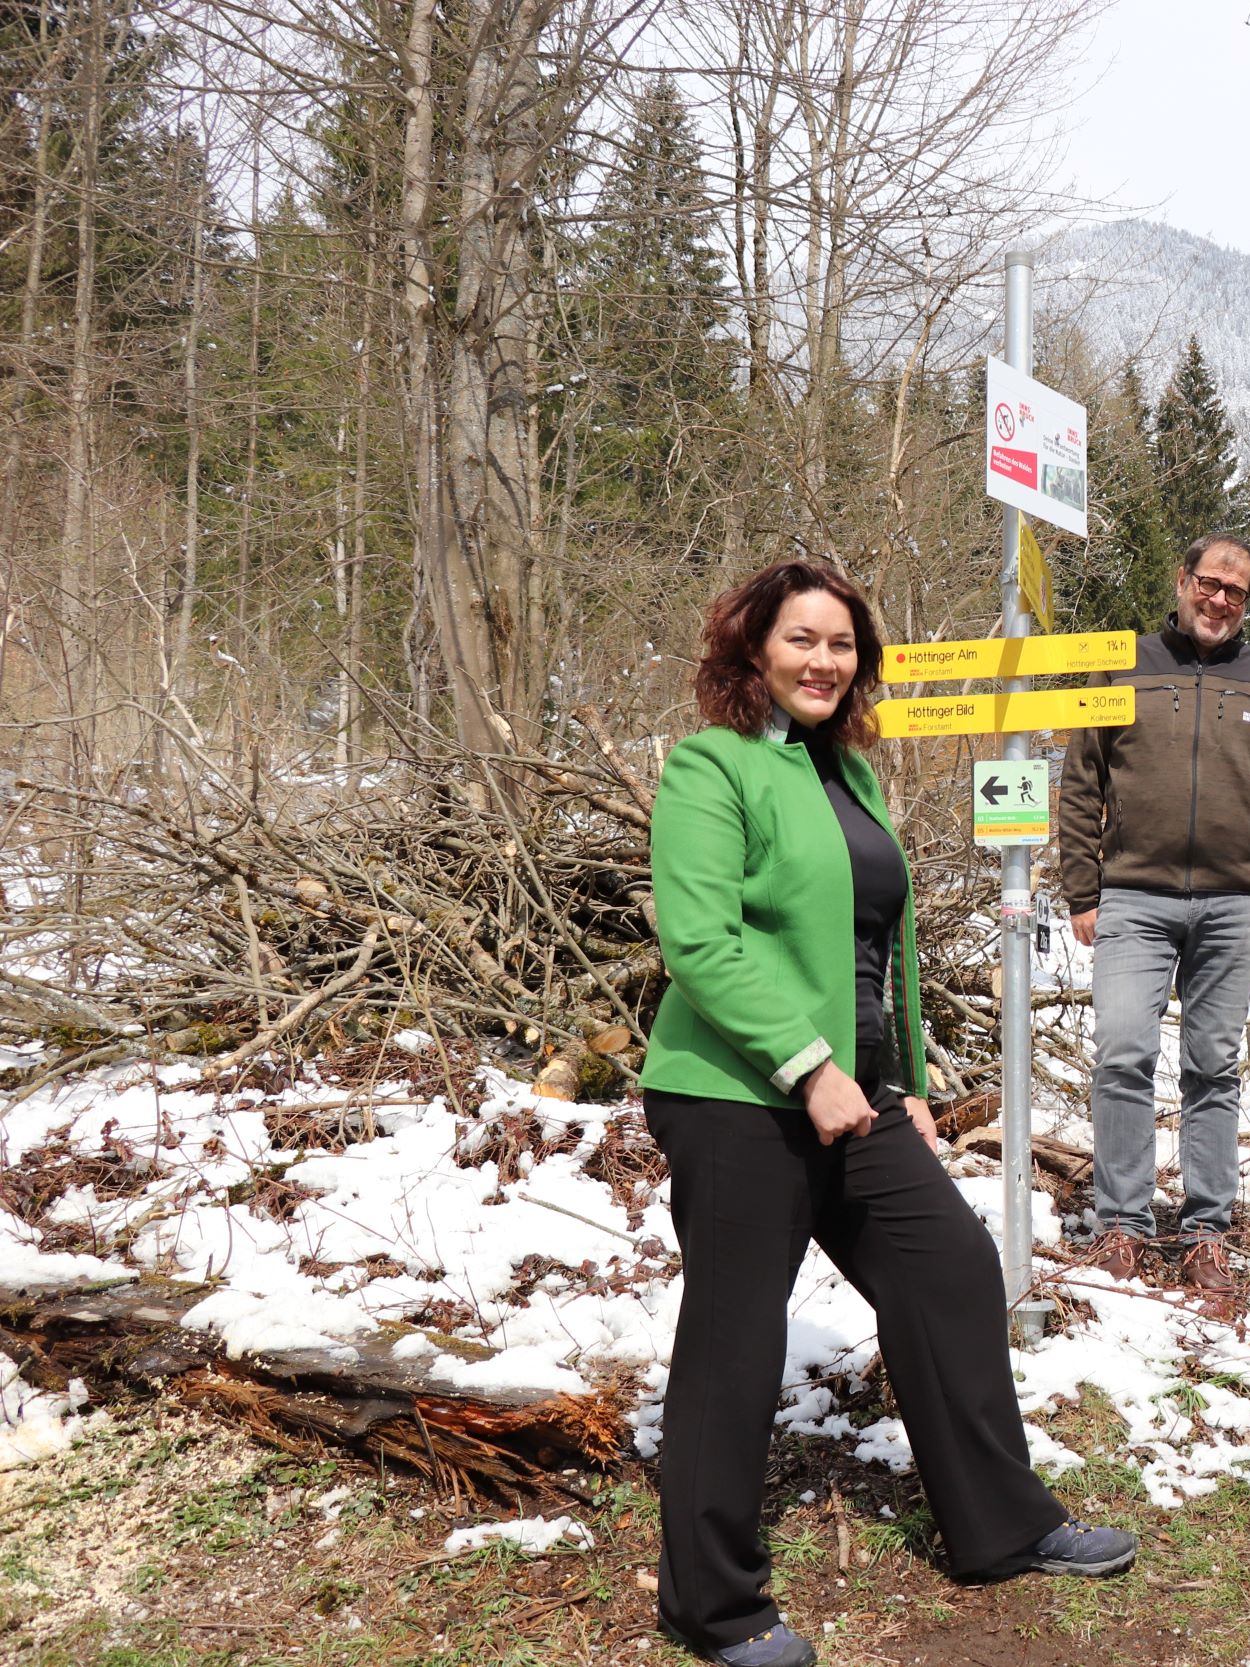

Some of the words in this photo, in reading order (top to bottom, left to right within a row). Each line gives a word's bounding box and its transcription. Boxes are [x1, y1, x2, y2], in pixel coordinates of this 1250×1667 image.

[1120, 640, 1127, 651] h
[909, 651, 955, 664] Höttinger
[958, 649, 977, 660] Alm
[924, 668, 953, 676] Forstamt
[1092, 696, 1106, 708] 30
[1108, 696, 1126, 707] min
[908, 706, 955, 719] Höttinger
[956, 704, 974, 716] Bild
[923, 723, 952, 731] Forstamt
